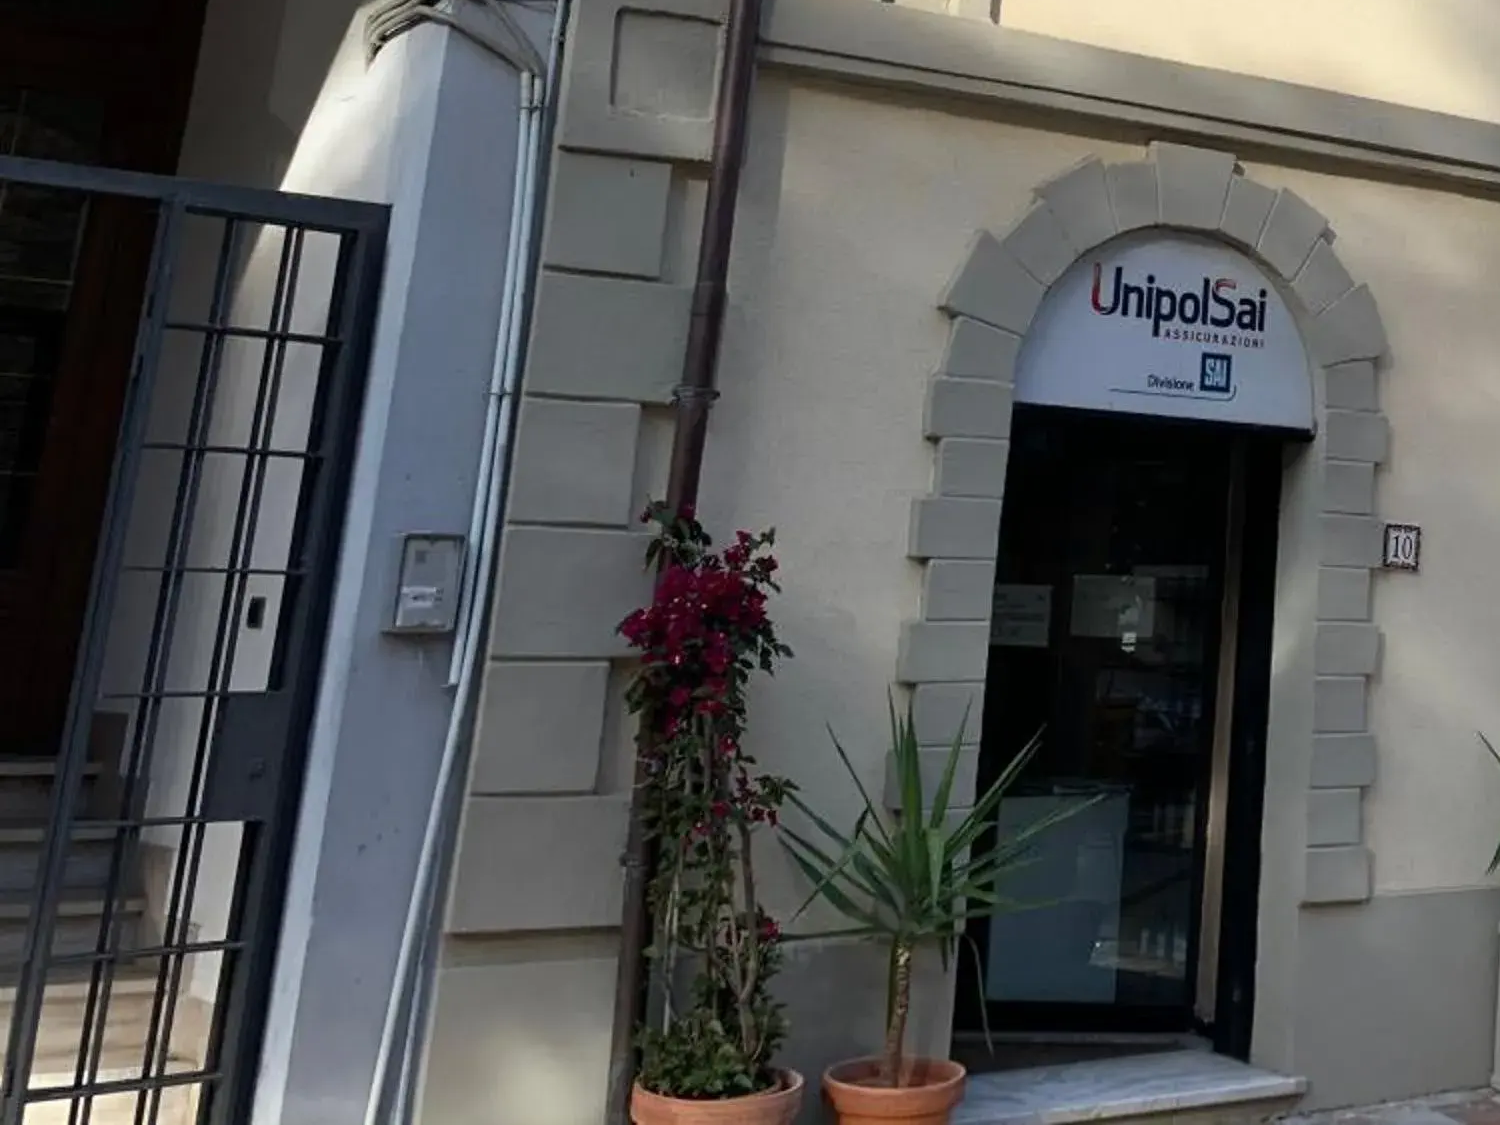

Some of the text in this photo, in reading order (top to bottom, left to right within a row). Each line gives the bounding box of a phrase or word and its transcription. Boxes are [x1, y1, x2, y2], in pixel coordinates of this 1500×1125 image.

[1091, 262, 1267, 338] UnipolSai
[1163, 328, 1265, 348] ASSICURAZIONI
[1147, 373, 1196, 391] Divisione
[1393, 535, 1413, 560] 10
